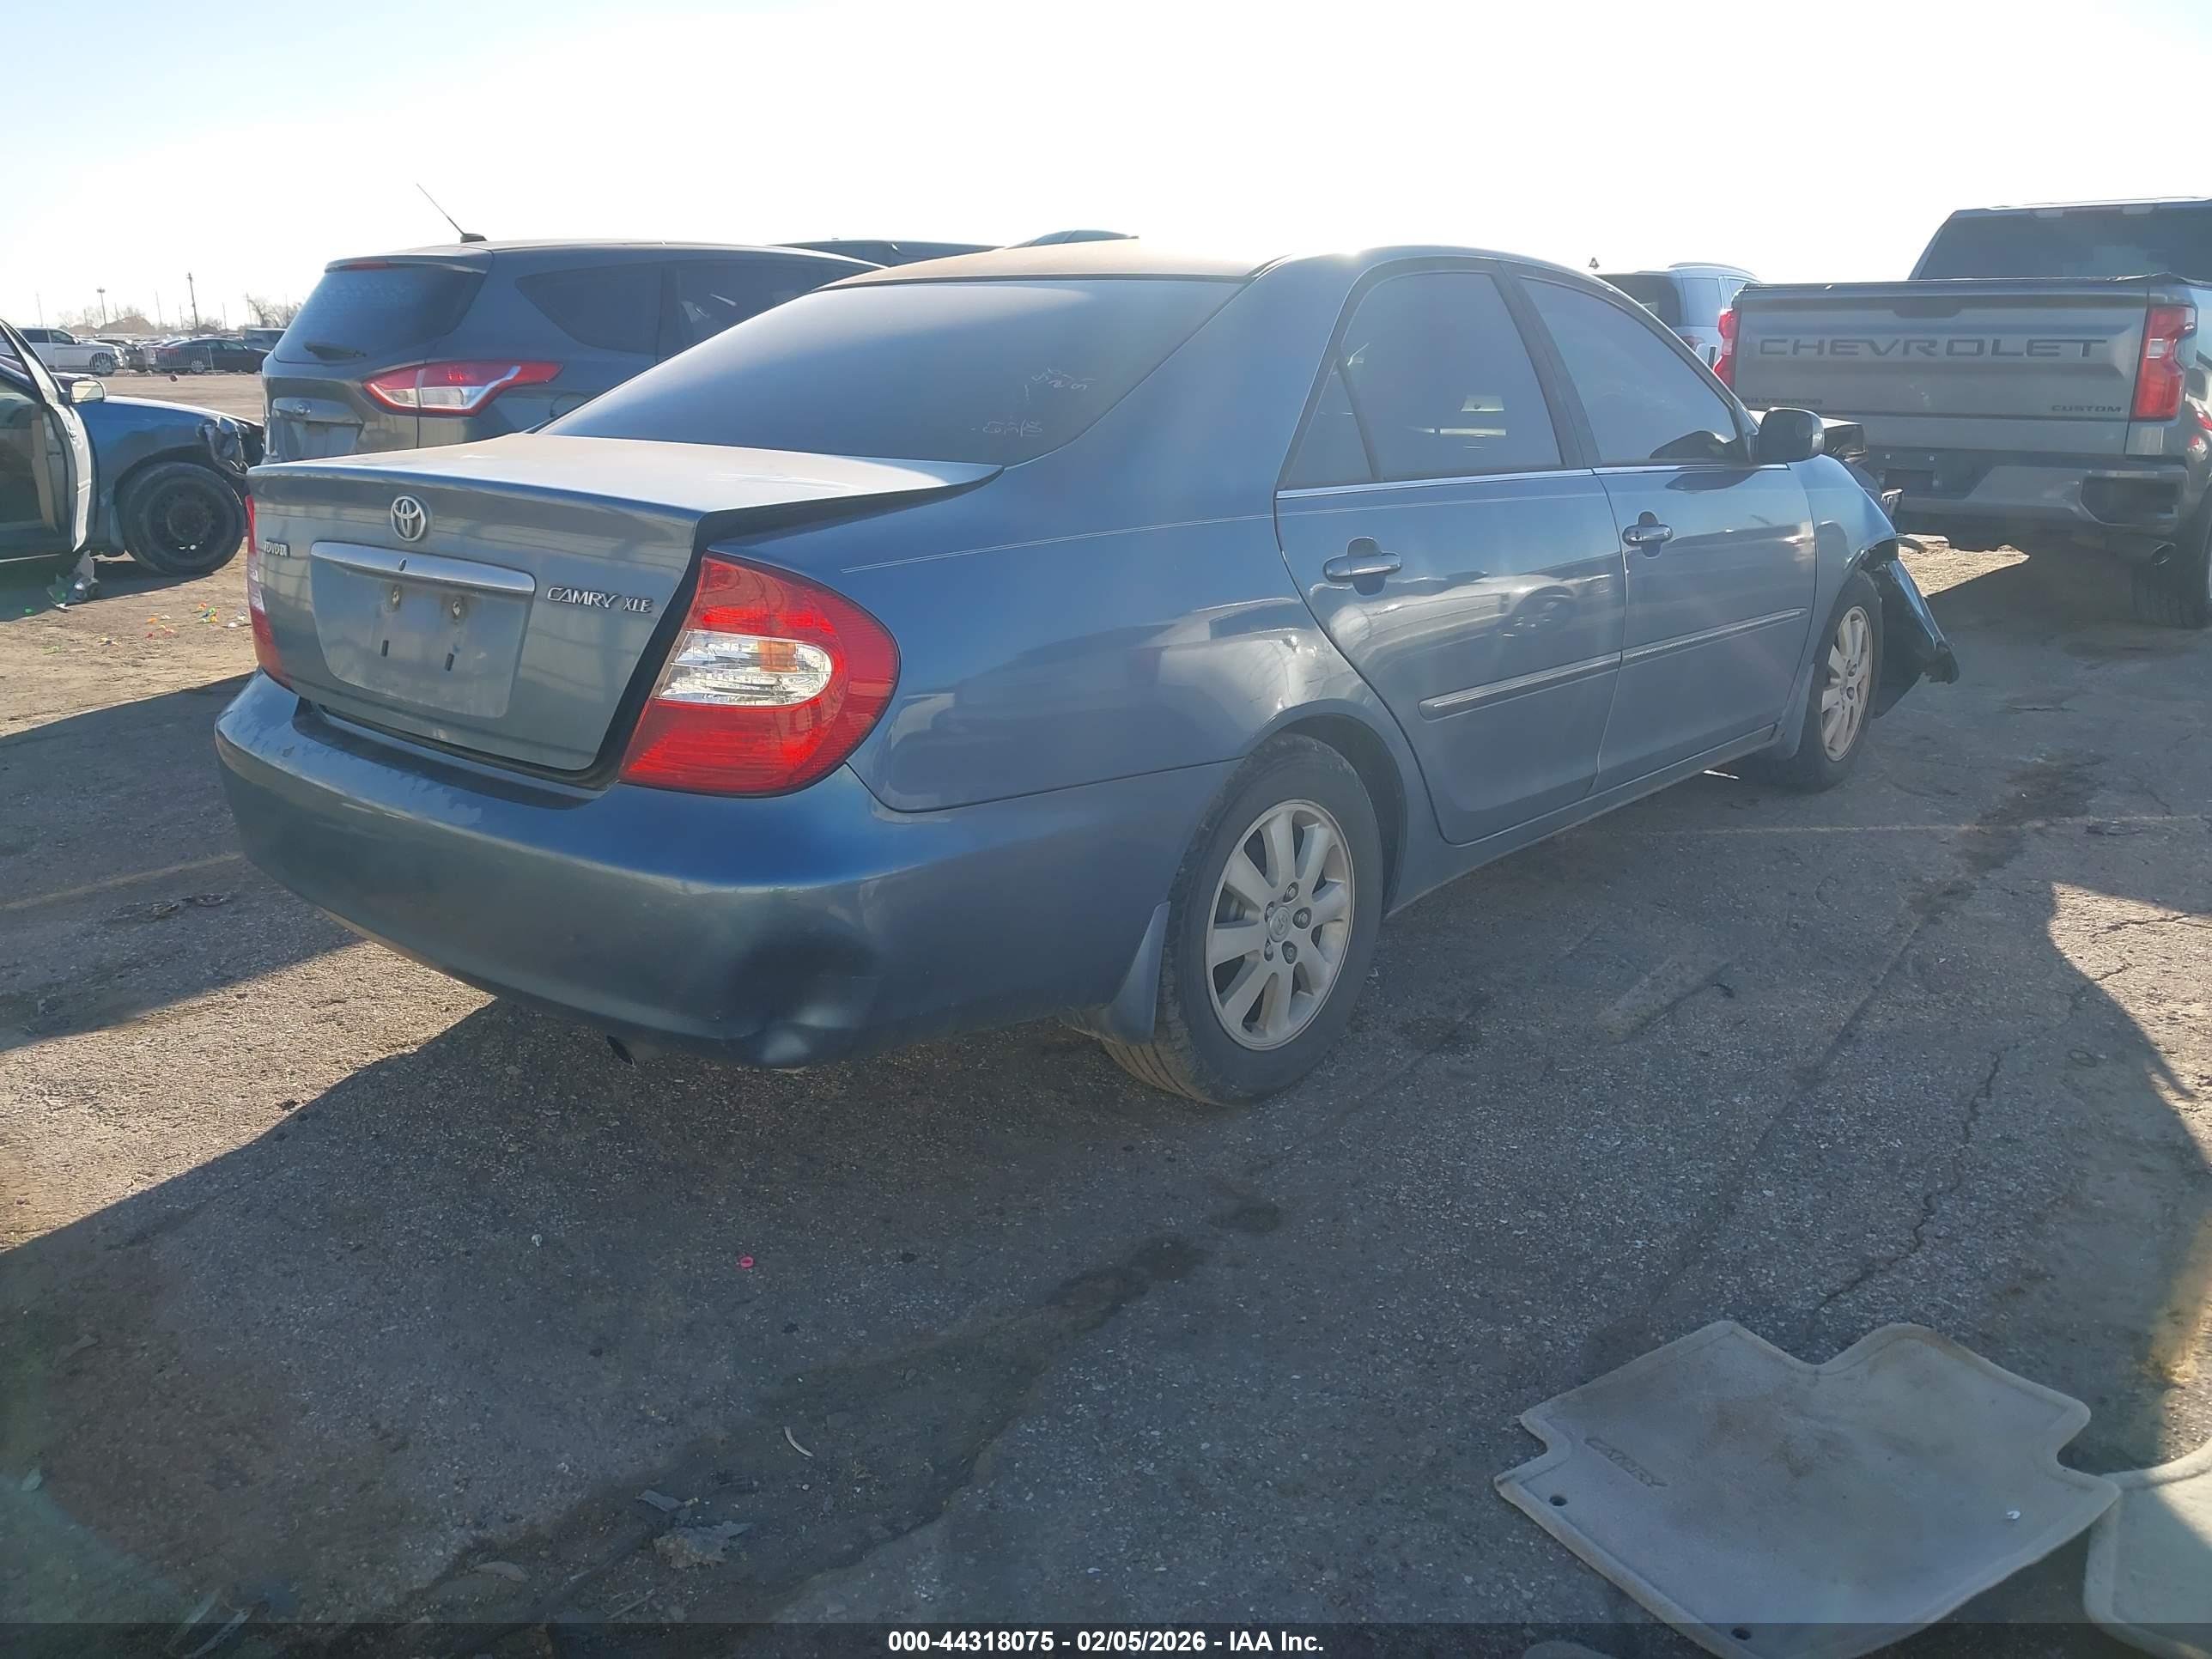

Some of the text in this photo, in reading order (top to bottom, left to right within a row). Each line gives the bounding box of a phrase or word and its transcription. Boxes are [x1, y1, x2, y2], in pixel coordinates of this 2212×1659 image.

[1759, 338, 2108, 358] CHEVROLET
[2051, 404, 2122, 413] CUSTOM
[547, 586, 652, 613] CAMRY XLE
